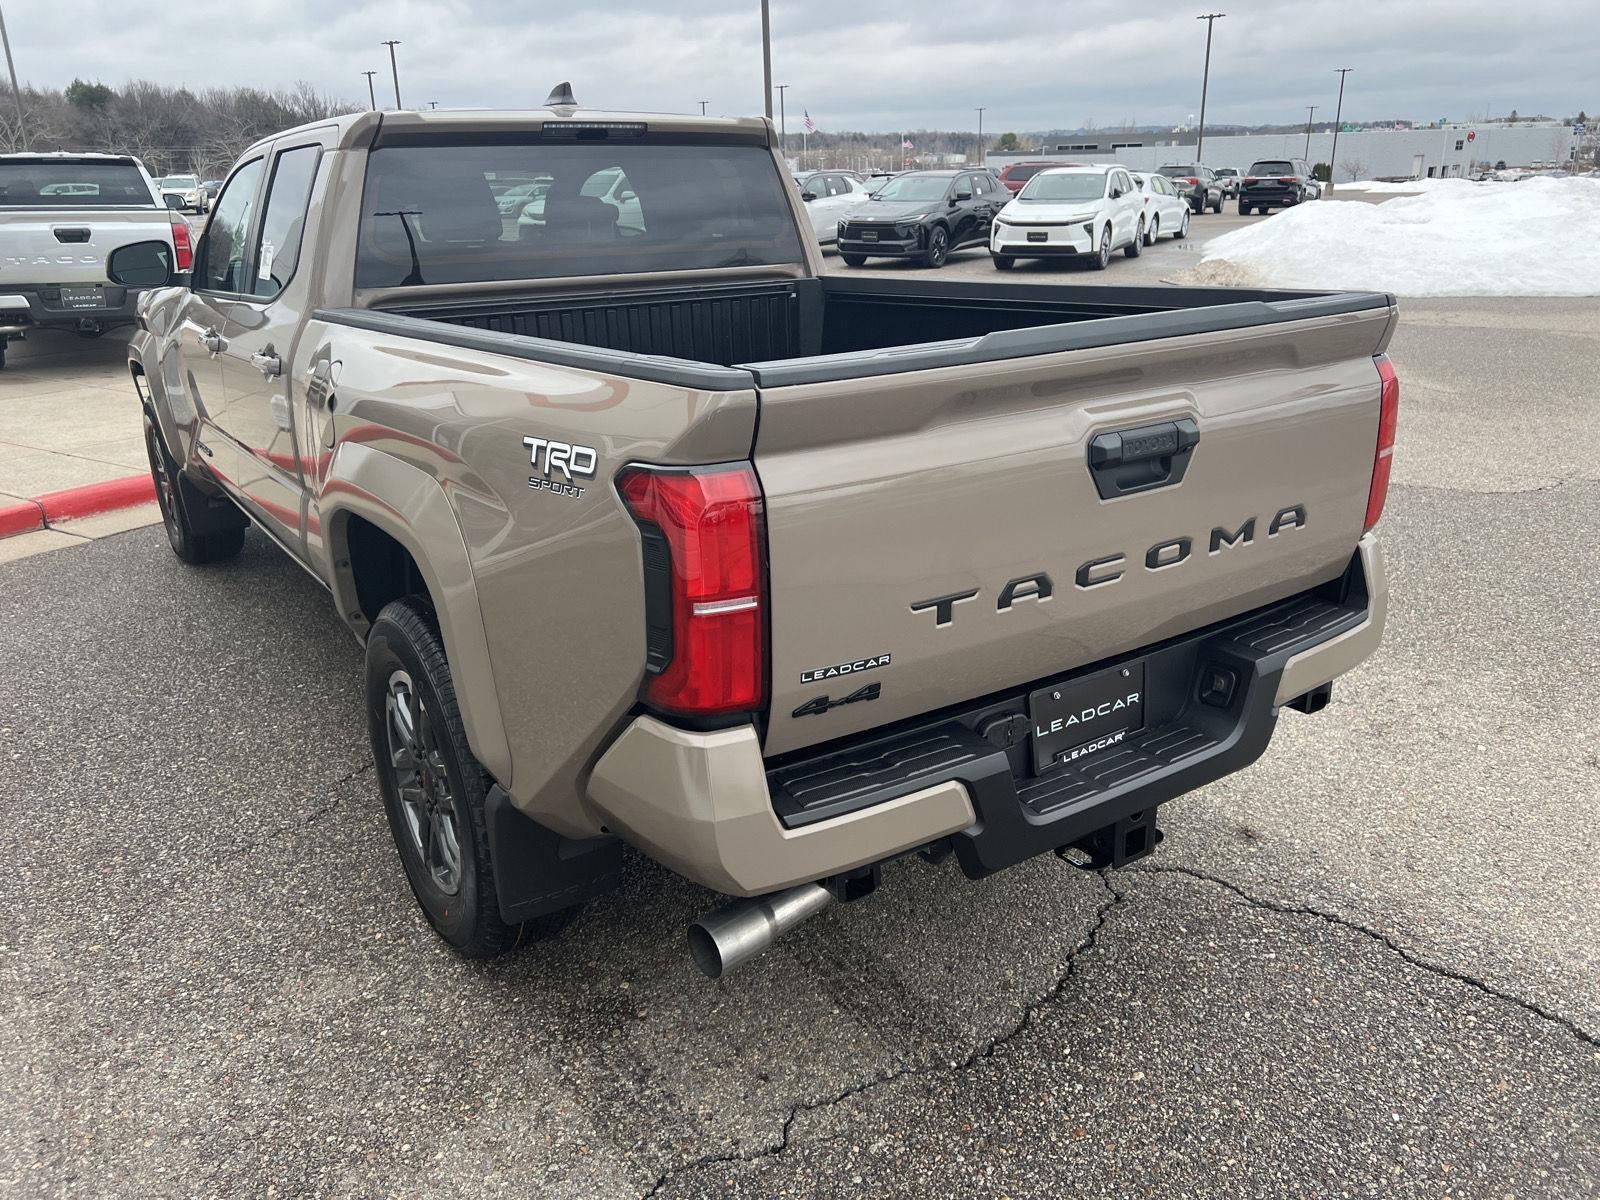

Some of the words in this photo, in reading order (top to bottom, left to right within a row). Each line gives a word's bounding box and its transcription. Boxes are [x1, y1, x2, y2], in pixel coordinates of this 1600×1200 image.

[522, 436, 598, 480] TRD
[1125, 432, 1176, 456] TOYOTA
[528, 476, 586, 499] SPORT
[910, 502, 1307, 629] TACOMA
[801, 655, 890, 683] LEADCAR
[1036, 692, 1140, 738] LEADCAR
[1063, 732, 1124, 763] LEADCAR
